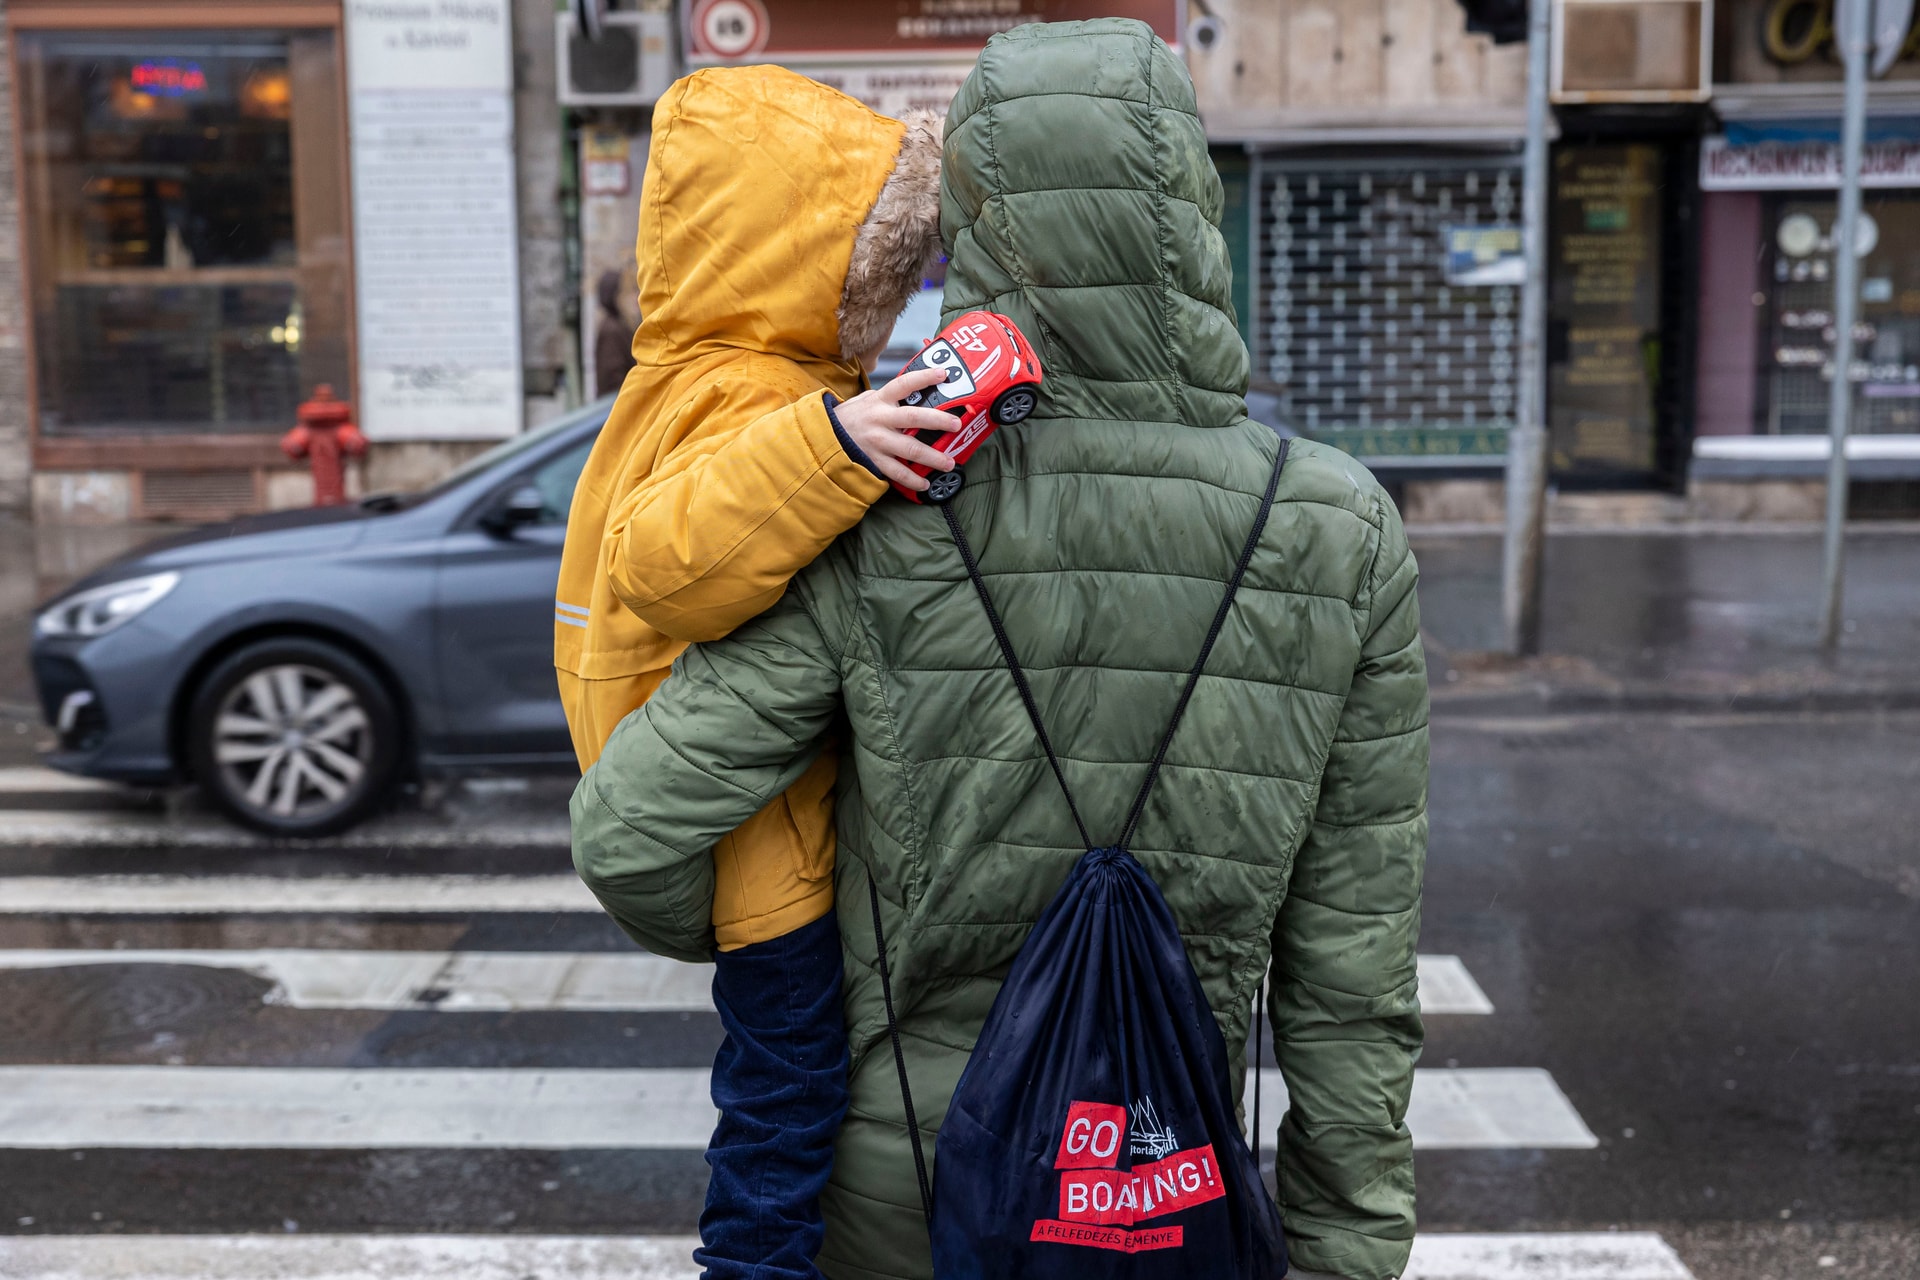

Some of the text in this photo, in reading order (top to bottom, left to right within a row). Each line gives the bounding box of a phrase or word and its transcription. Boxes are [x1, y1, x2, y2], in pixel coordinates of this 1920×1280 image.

[952, 326, 988, 352] 45
[963, 415, 987, 442] 45
[1066, 1117, 1119, 1157] GO
[1067, 1157, 1215, 1213] BOATING!
[1037, 1226, 1174, 1248] A FELFEDEZÉS ÉMÉNYE
